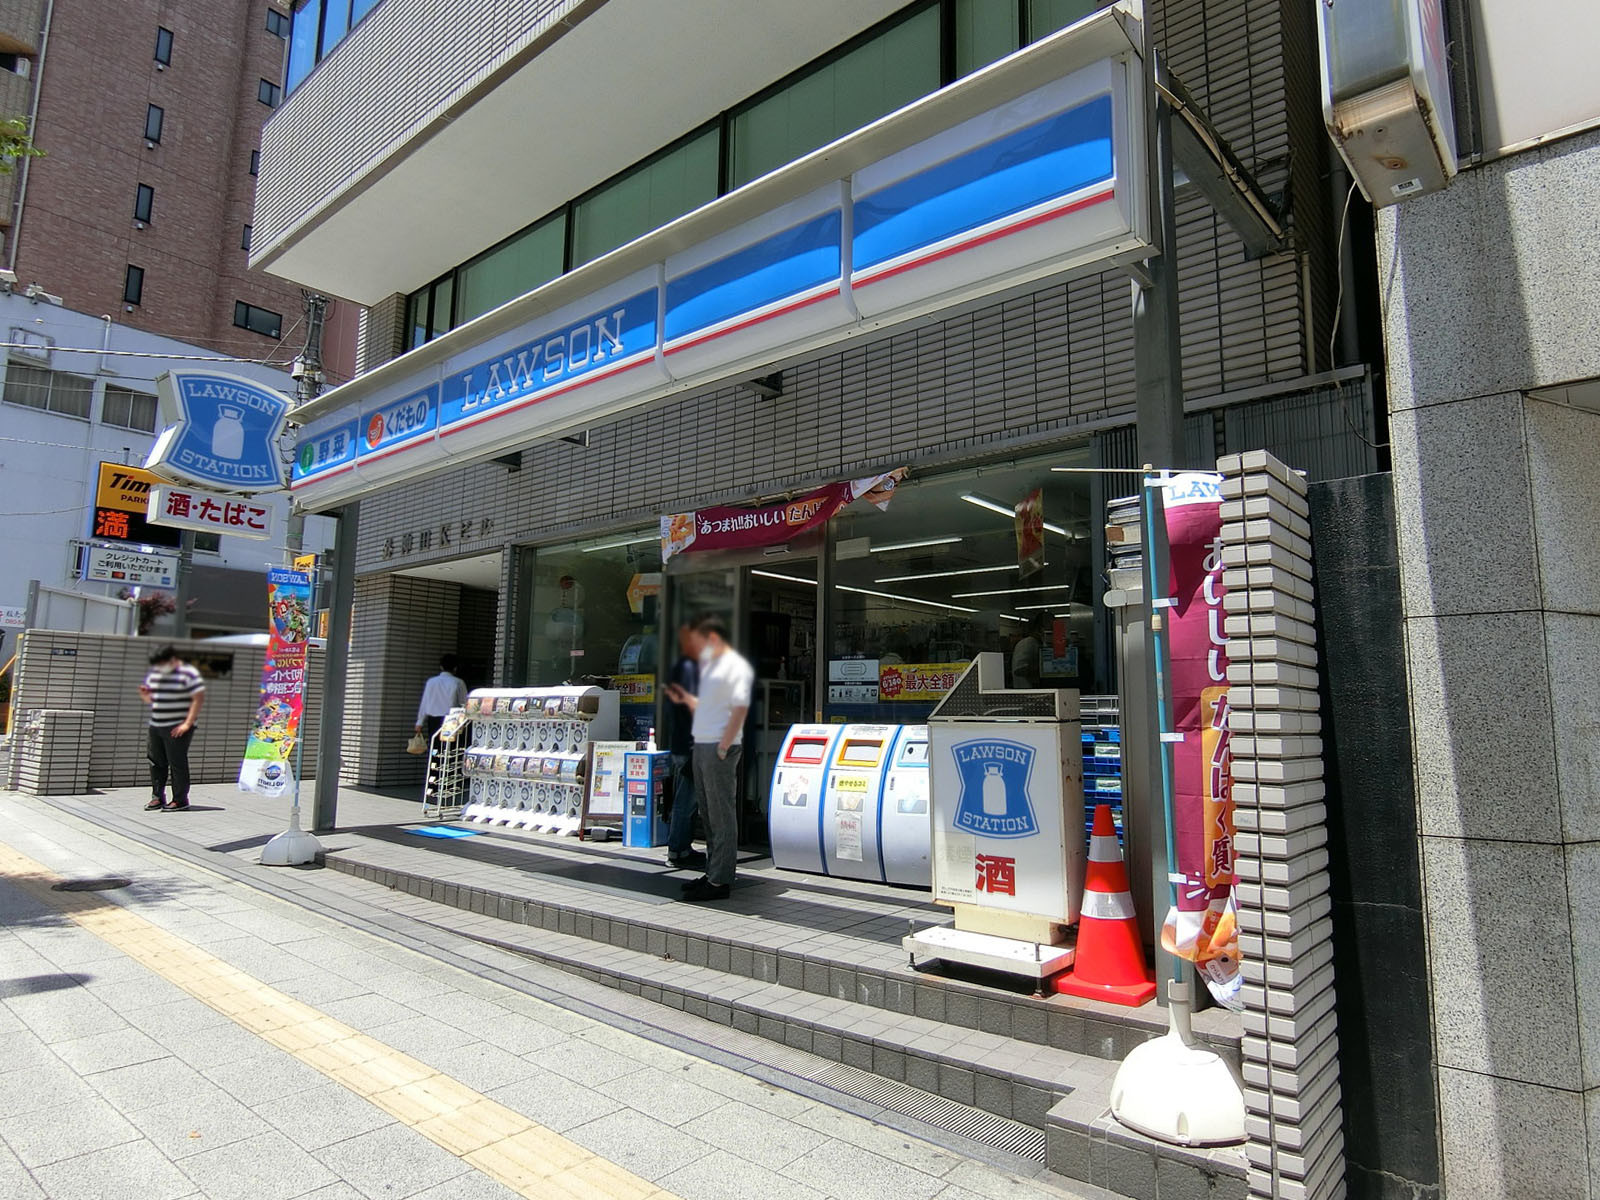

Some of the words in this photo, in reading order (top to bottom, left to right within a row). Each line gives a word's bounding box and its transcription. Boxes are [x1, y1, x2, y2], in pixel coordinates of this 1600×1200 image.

[461, 308, 626, 412] LAWSON
[187, 383, 278, 416] LAWSON
[386, 400, 427, 438] くだもの
[318, 432, 346, 461] 野菜
[180, 448, 270, 478] STATION
[110, 473, 152, 494] Tim
[95, 510, 130, 539] 満
[166, 491, 267, 530] 酒・たばこ
[97, 560, 169, 574] ご利用いただけます
[105, 552, 164, 566] クレジットカード
[959, 745, 1028, 765] LAWSON
[962, 811, 1030, 833] STATION
[975, 852, 1016, 896] 酒
